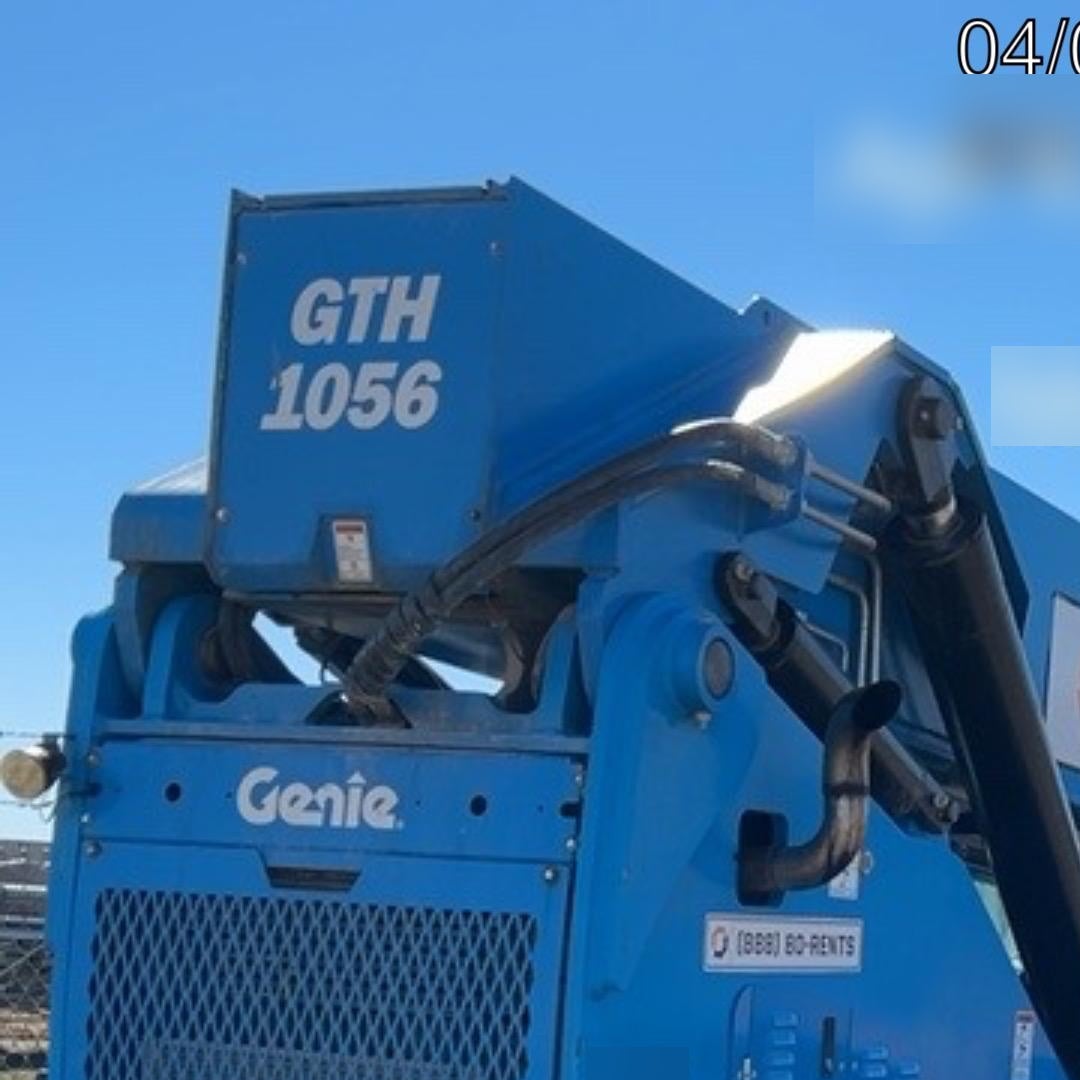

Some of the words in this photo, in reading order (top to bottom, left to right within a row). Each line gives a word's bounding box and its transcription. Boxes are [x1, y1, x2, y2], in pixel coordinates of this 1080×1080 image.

[290, 274, 441, 345] GTH
[259, 359, 442, 430] 1056
[236, 767, 399, 829] Genie
